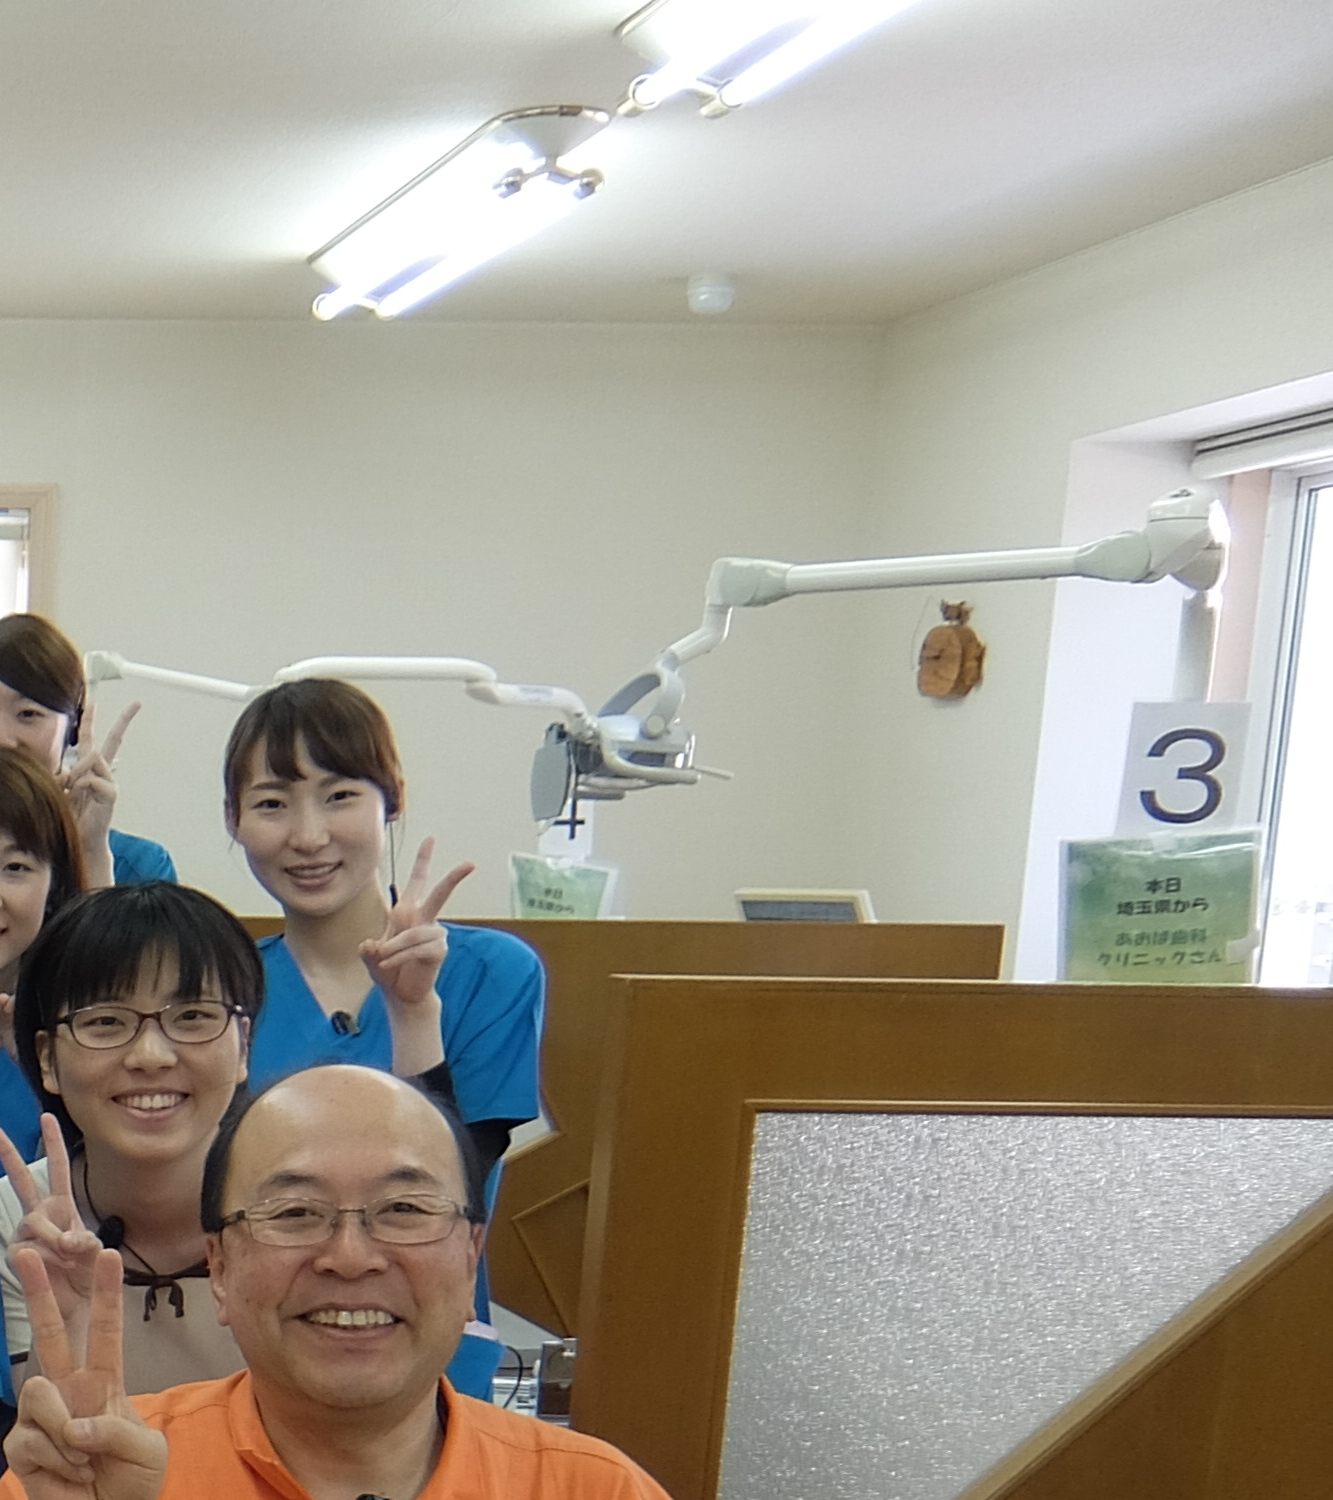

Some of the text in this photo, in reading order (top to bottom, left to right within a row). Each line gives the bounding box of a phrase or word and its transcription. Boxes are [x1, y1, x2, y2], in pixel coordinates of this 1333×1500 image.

[1139, 727, 1226, 824] 3
[1146, 877, 1182, 894] 本日
[1117, 897, 1209, 916] 埼玉県から
[1098, 948, 1222, 966] クリニックさん
